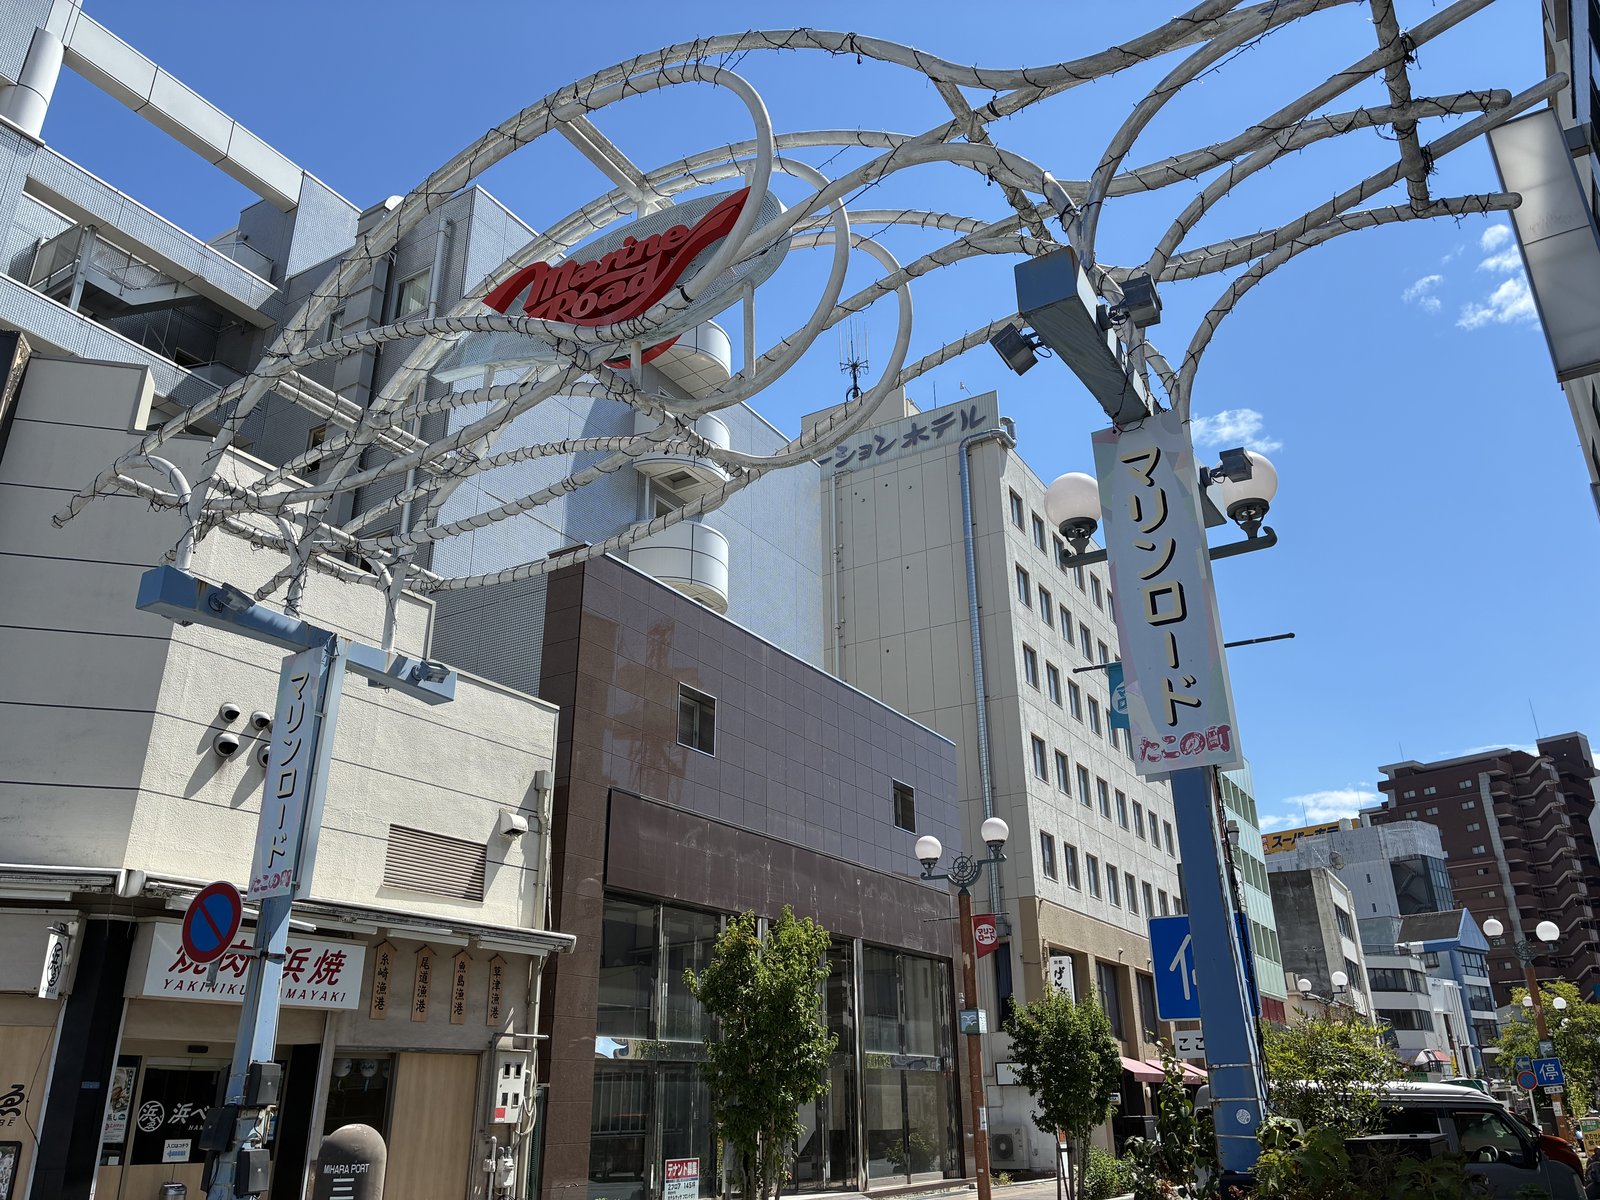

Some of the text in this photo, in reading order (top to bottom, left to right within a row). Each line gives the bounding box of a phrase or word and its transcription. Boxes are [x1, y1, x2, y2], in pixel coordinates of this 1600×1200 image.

[500, 225, 692, 313] Marine
[538, 250, 664, 323] Road
[1120, 447, 1202, 727] マリンロード
[268, 672, 310, 868] マリンロード
[1138, 724, 1232, 763] たこの町
[374, 952, 390, 1011] 糸崎漁港
[415, 956, 430, 1013] 尾道漁港
[1539, 1062, 1559, 1081] 停
[323, 1163, 370, 1174] MIHARA PORT
